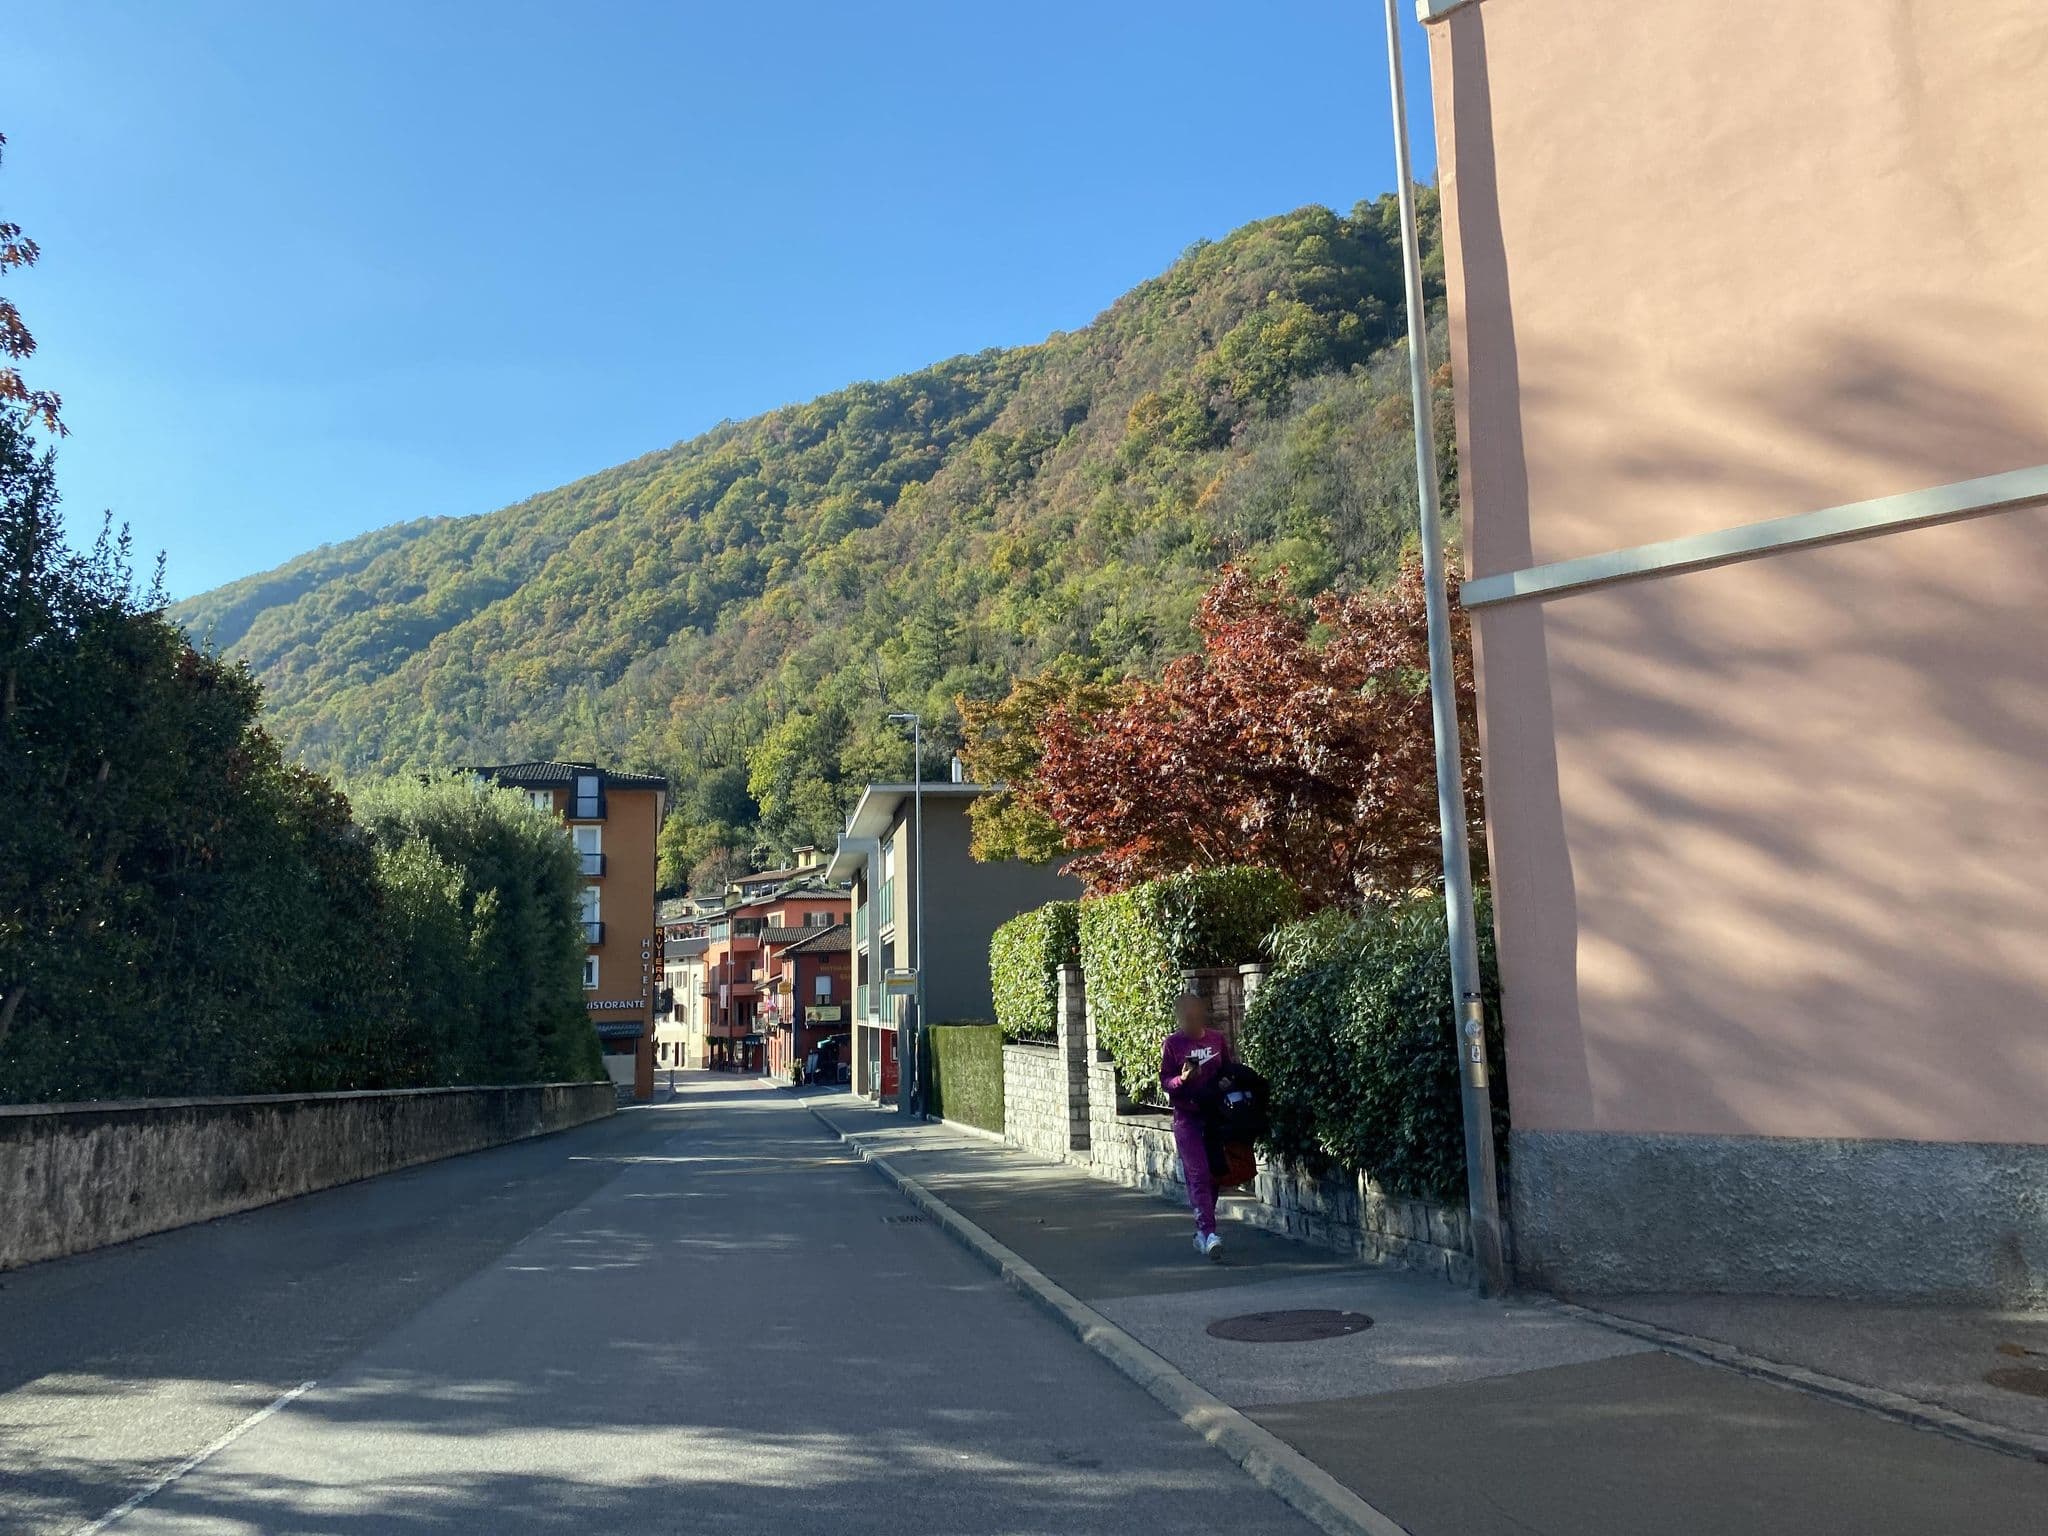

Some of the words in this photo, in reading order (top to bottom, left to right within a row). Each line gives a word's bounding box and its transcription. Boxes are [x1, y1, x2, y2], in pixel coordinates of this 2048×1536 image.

[642, 939, 650, 996] HOTEL
[655, 928, 663, 980] RIVIERA
[1191, 1047, 1212, 1059] NIKE
